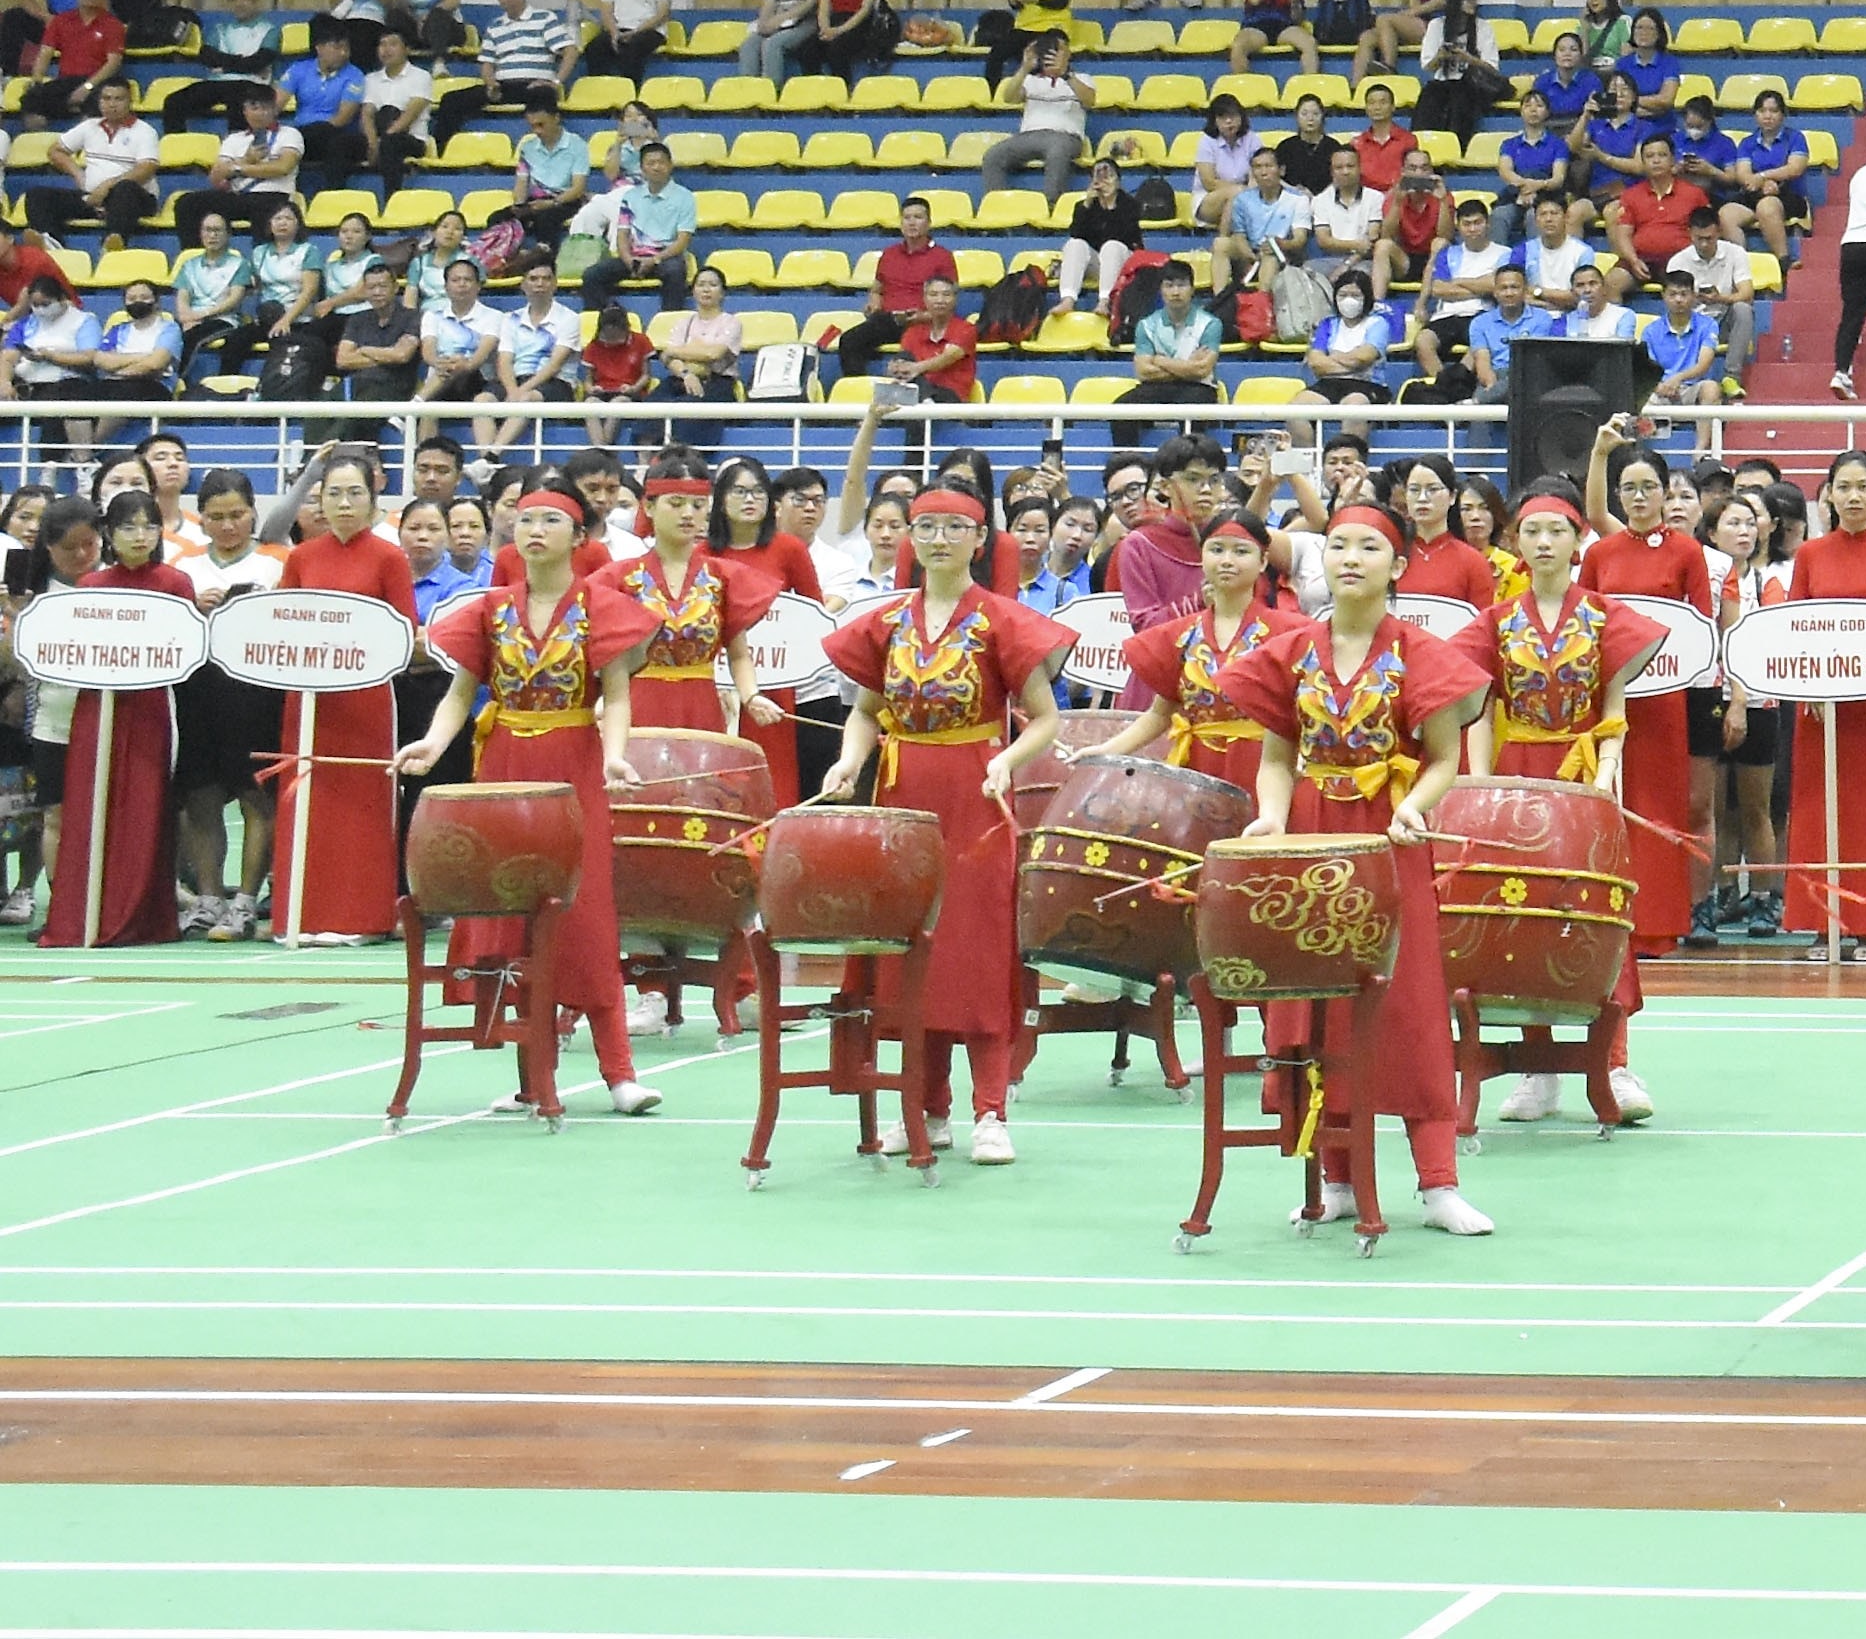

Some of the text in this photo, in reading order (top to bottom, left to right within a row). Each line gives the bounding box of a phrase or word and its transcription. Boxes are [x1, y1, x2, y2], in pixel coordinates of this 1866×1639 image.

[1791, 614, 1836, 632] NGÀNH
[36, 637, 183, 672] HUYỆN THẠCH THẤT
[244, 641, 366, 672] HUYỆN MỸ ĐỨC
[771, 640, 787, 669] VÌ
[1766, 650, 1821, 684] HUYỆN
[1827, 647, 1862, 679] ỨNG
